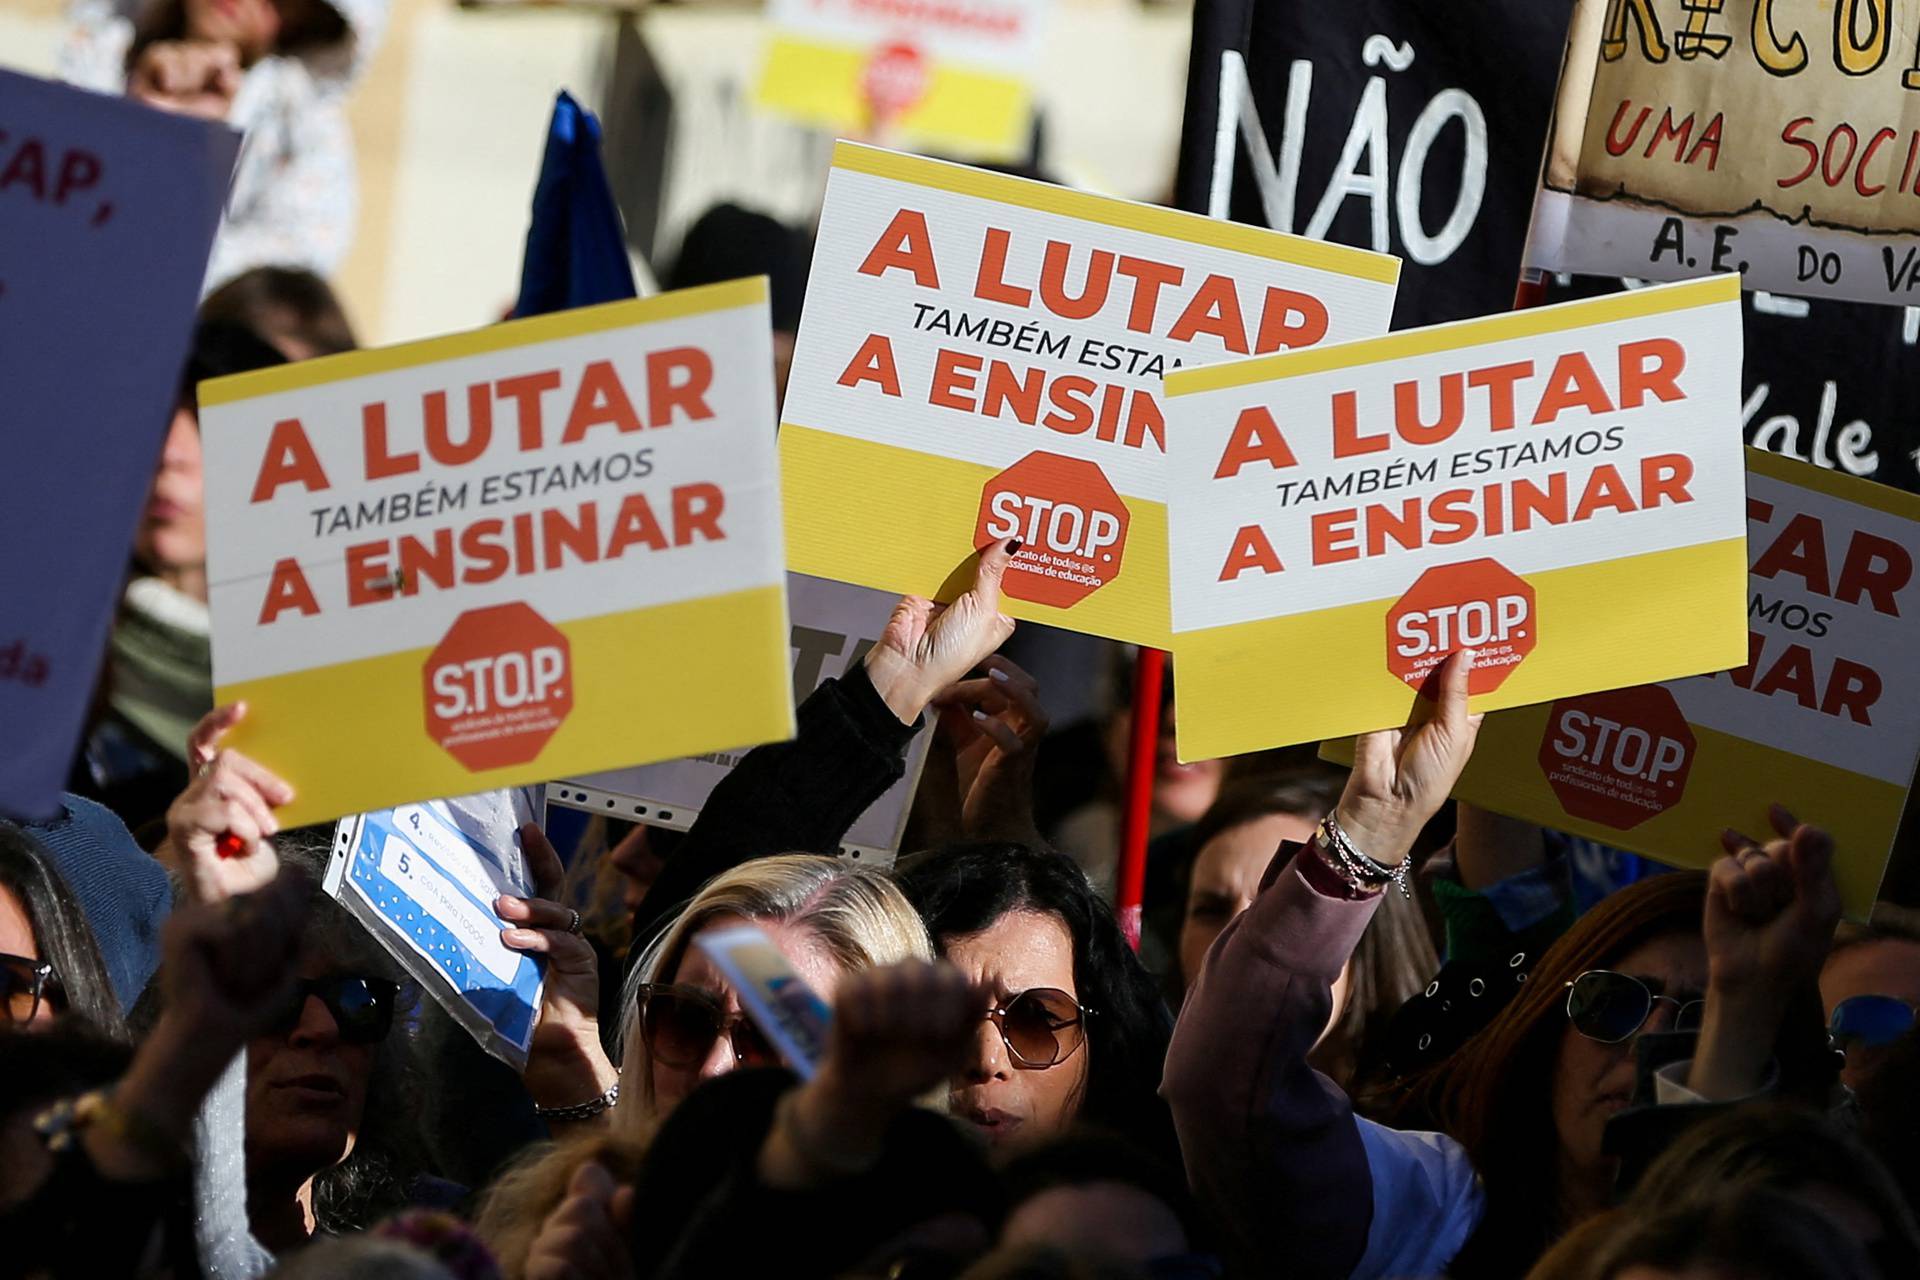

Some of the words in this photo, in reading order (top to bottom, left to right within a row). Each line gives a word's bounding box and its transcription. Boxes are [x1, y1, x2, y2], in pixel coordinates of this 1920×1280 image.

[1209, 34, 1489, 266] NÃO
[1605, 99, 1723, 171] UMA
[1777, 117, 1920, 196] SOCI
[857, 208, 941, 290] A
[973, 226, 1330, 356] LUTAR
[1797, 245, 1842, 285] DO
[836, 333, 902, 398] A
[912, 303, 1071, 359] TAMBÉM
[1078, 340, 1182, 381] ESTA
[249, 418, 331, 504] A
[361, 345, 716, 481] LUTAR
[1213, 405, 1299, 479] A
[1331, 337, 1688, 460] LUTAR
[310, 480, 468, 538] TAMBÉM
[480, 448, 654, 505] ESTAMOS
[1276, 458, 1438, 507] TAMBÉM
[1448, 426, 1625, 479] ESTAMOS
[258, 557, 322, 625] A
[345, 481, 727, 607] ENSINAR
[987, 491, 1120, 562] S.T.O.P.
[1217, 524, 1285, 582] A
[1311, 452, 1696, 567] ENSINAR
[1008, 559, 1045, 574] ssionais
[1057, 569, 1102, 587] educação
[1396, 595, 1528, 658] S.T.O.P.
[1748, 592, 1833, 638] MOS
[433, 646, 565, 719] S.T.O.P.
[1553, 710, 1686, 788] S.T.O.P.
[409, 812, 424, 837] 4.
[398, 852, 414, 880] 5.
